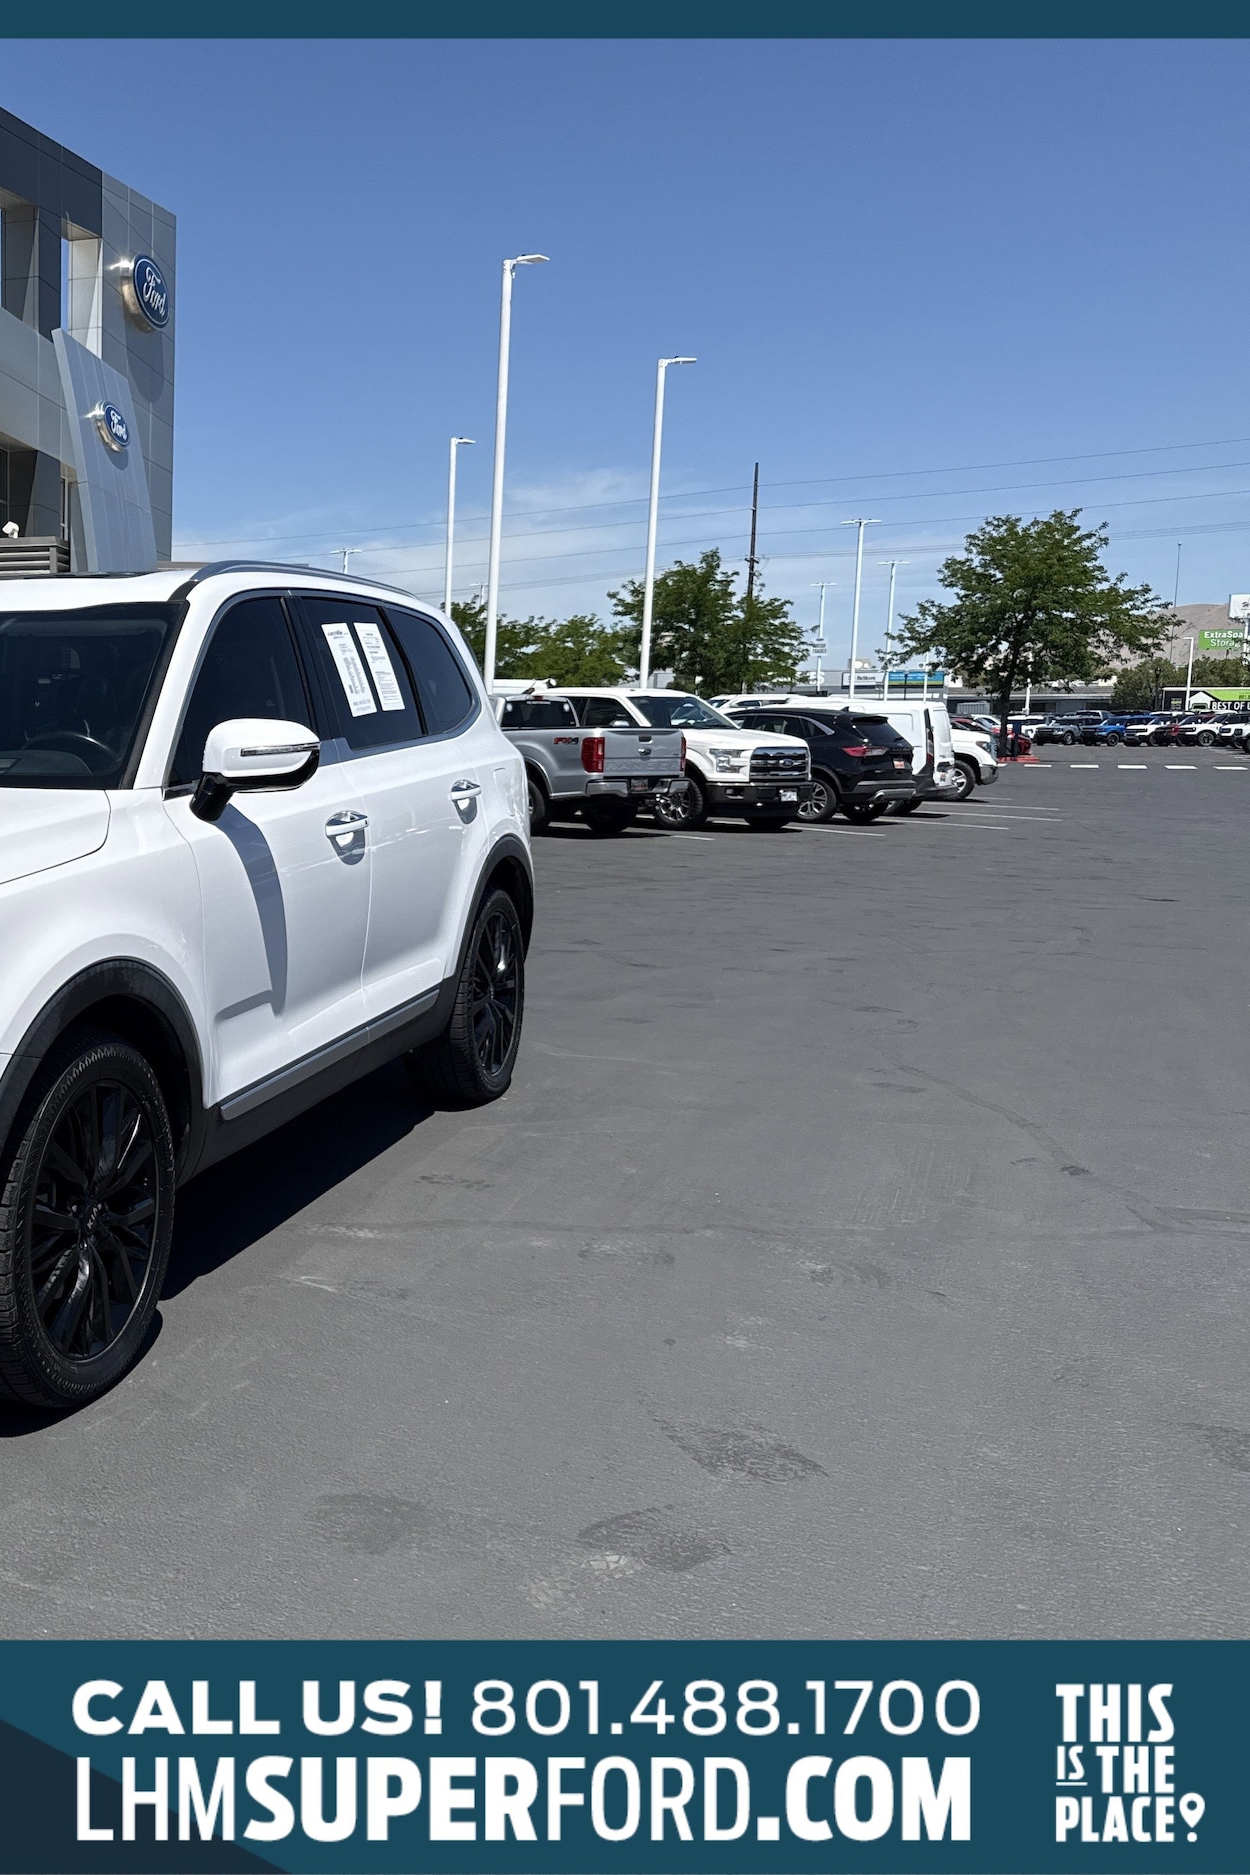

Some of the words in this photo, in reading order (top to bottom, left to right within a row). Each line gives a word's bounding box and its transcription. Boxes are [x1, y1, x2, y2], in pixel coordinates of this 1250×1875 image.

[142, 266, 167, 318] Ford
[110, 409, 128, 441] Ford
[1212, 701, 1232, 710] BEST
[1234, 701, 1246, 710] OF
[554, 737, 579, 745] FX4
[607, 761, 679, 771] RANGER
